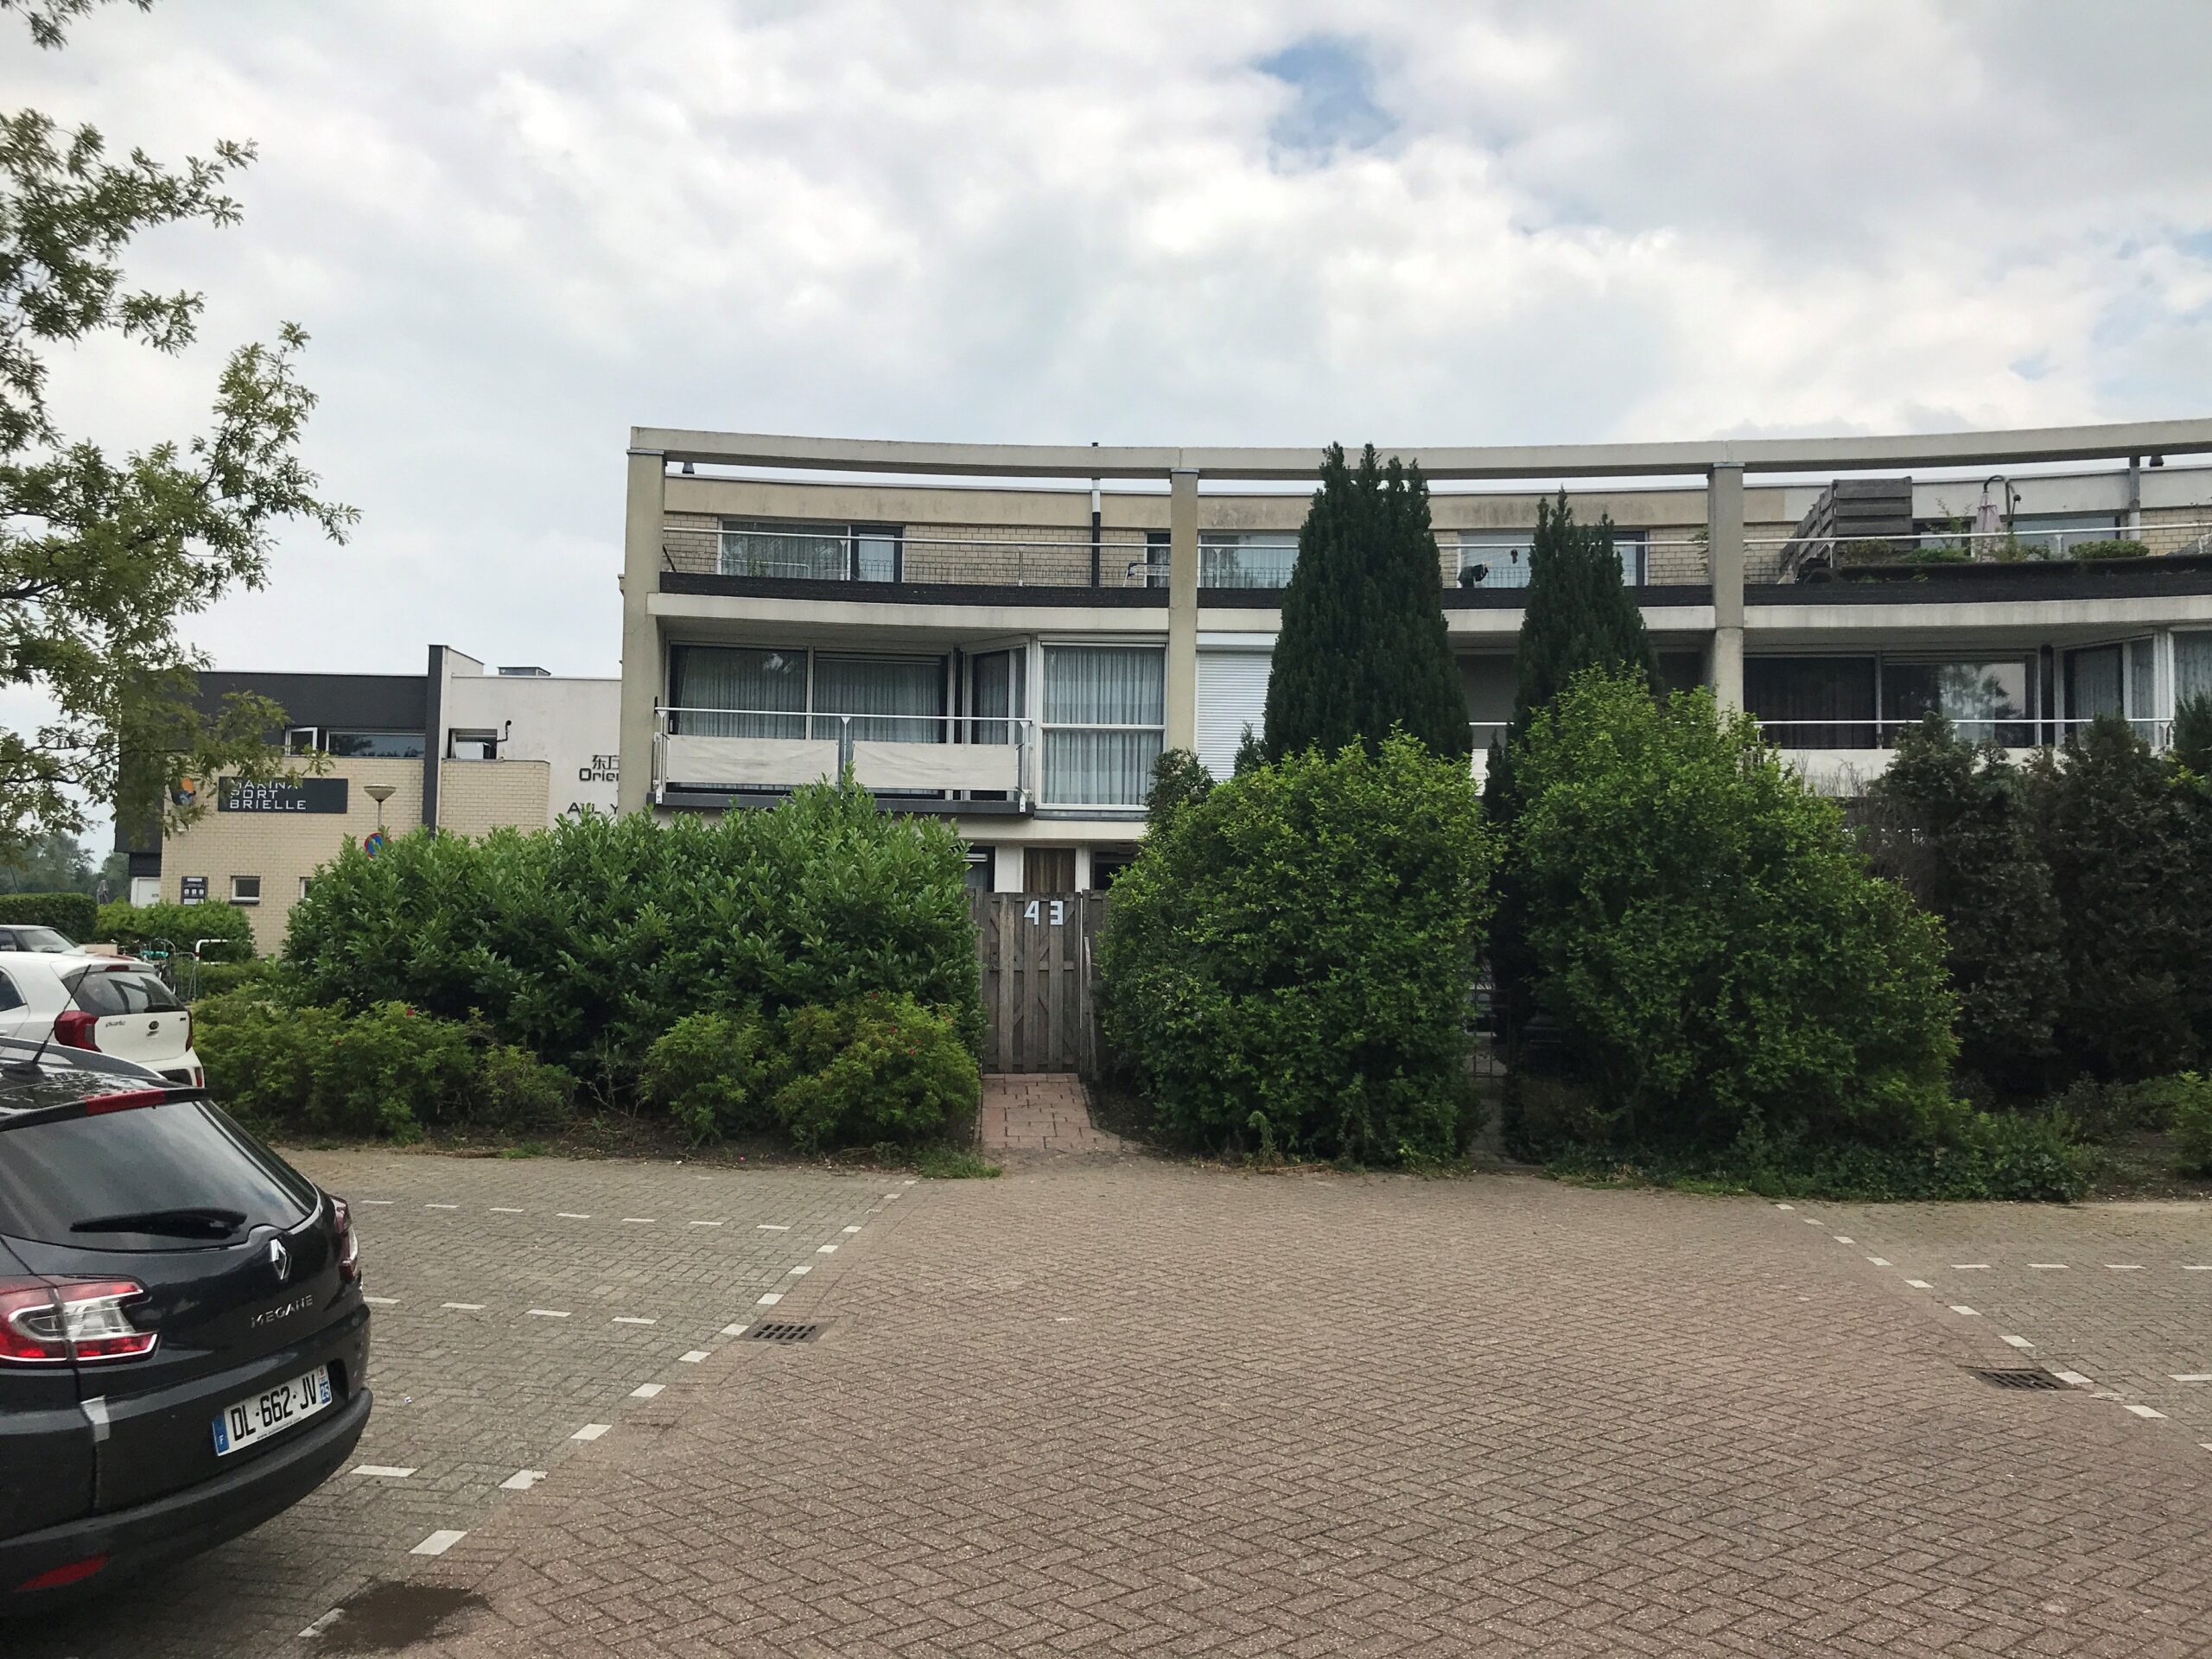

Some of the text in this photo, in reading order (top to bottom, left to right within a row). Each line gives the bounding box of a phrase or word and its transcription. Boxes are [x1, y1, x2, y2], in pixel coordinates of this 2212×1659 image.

[230, 789, 278, 799] PORT
[230, 799, 307, 810] BRIELLE
[1023, 900, 1064, 925] 43
